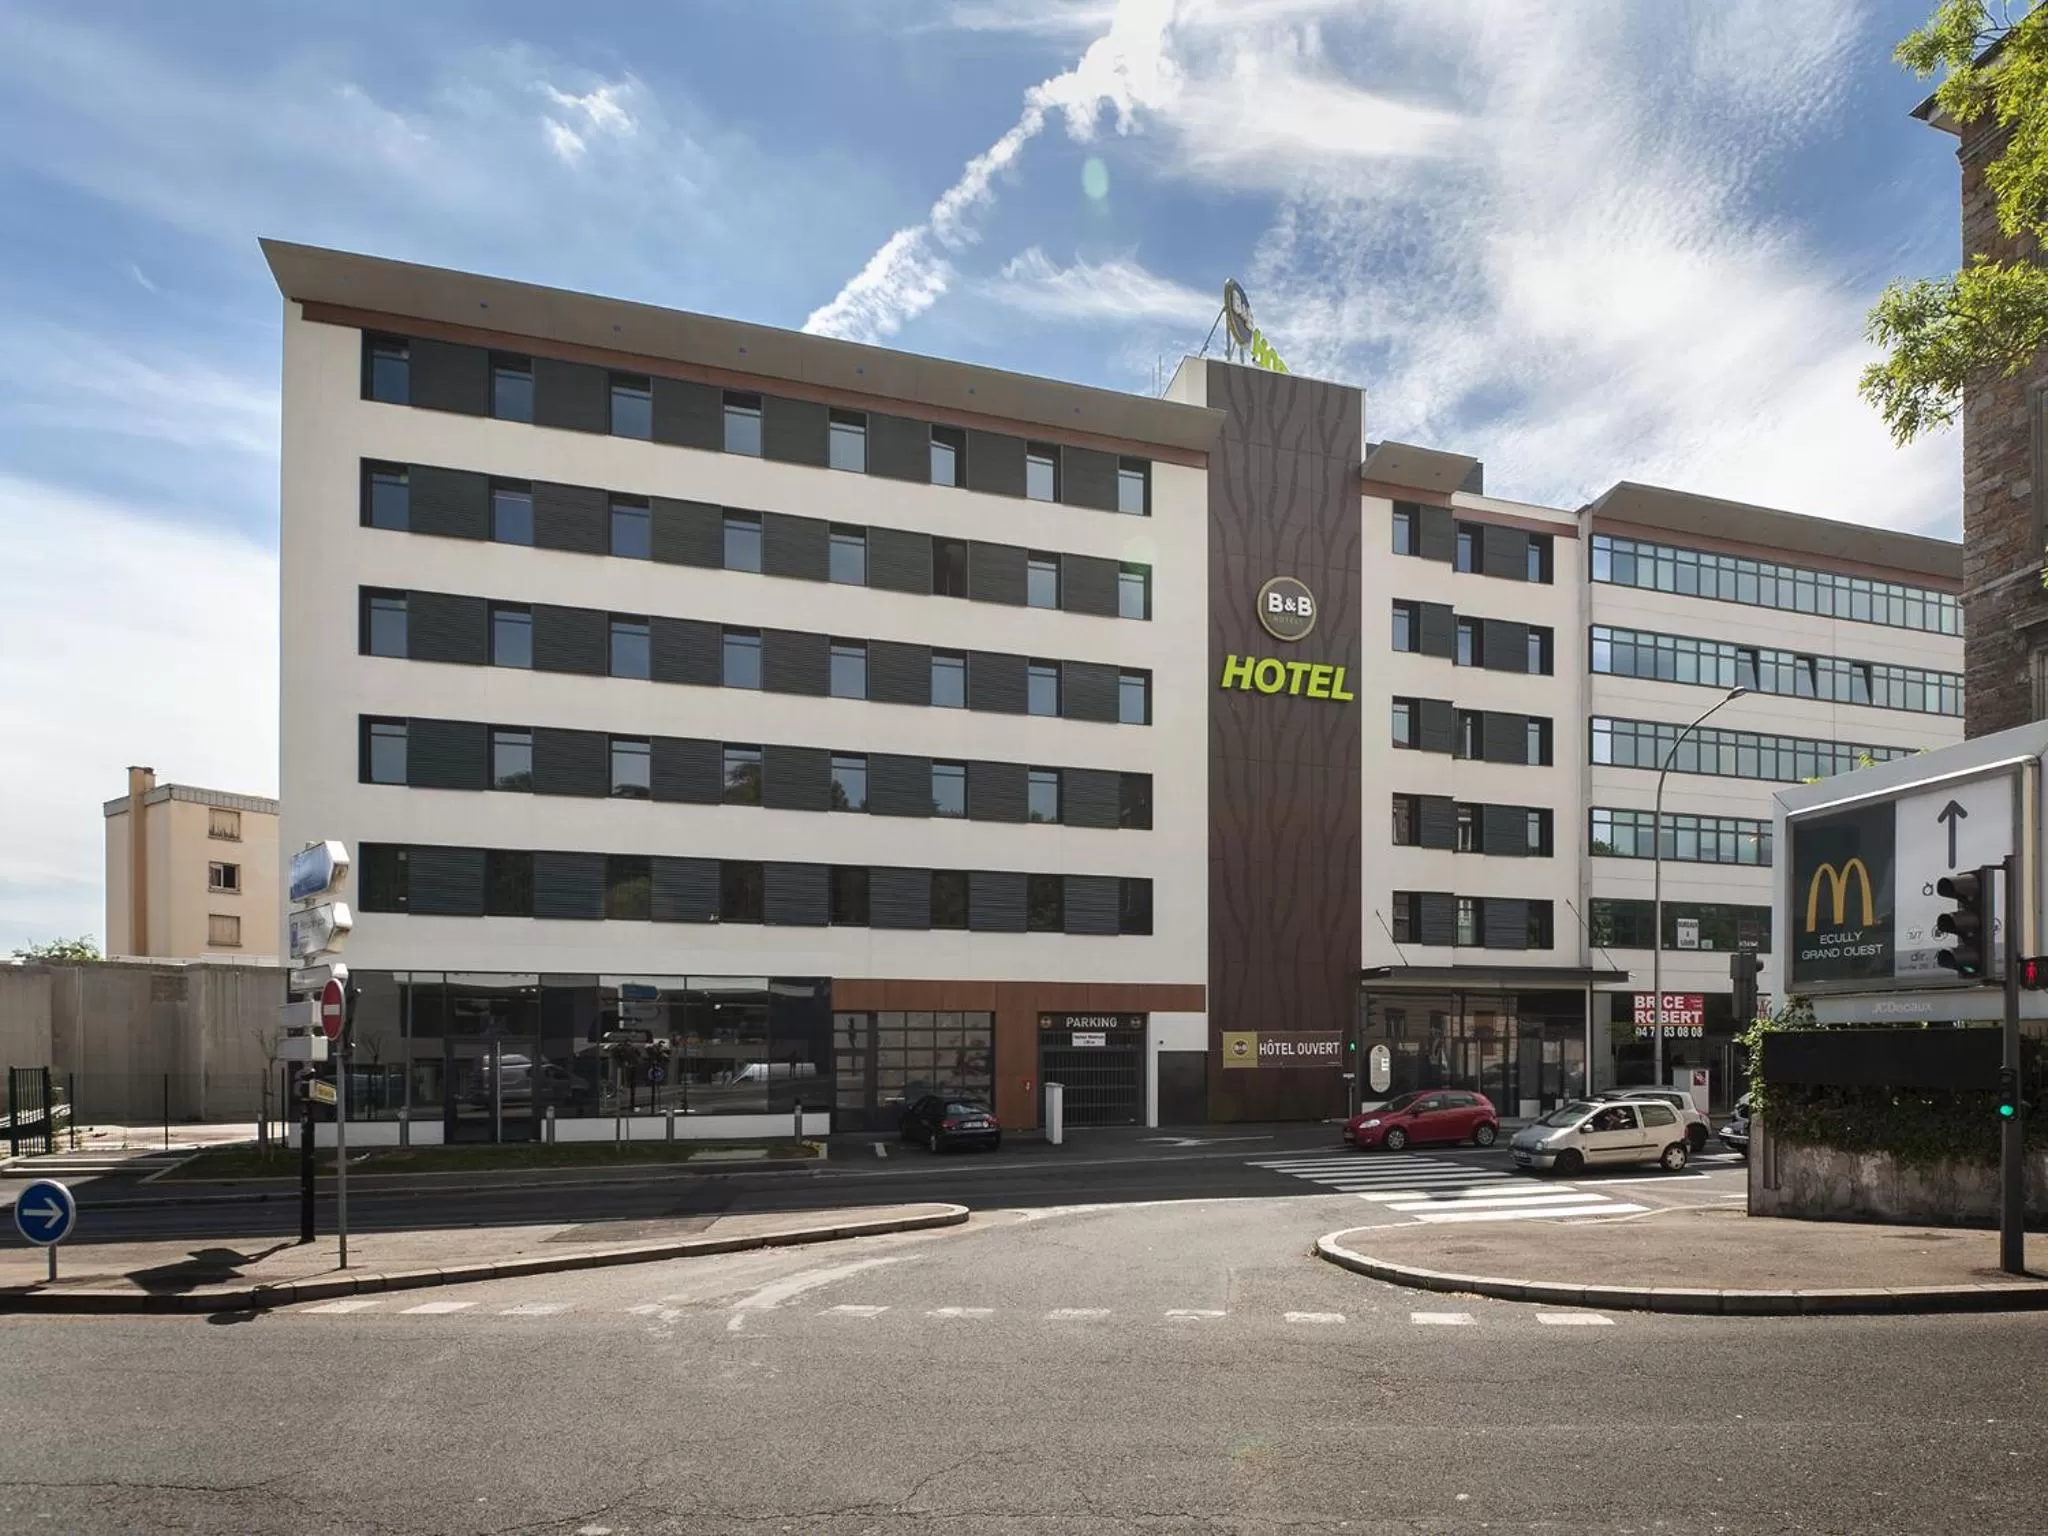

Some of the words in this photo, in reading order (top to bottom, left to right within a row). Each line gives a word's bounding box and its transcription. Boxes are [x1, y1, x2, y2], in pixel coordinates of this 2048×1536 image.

[1269, 592, 1312, 616] B&B
[1221, 655, 1354, 701] HOTEL
[1820, 931, 1862, 944] ECULLY
[1802, 948, 1840, 960] GRAND
[1843, 944, 1884, 957] OUEST
[1635, 996, 1684, 1009] BRCE
[1066, 1016, 1117, 1028] PARKING
[1635, 1011, 1702, 1024] ROBERT
[1664, 1026, 1675, 1037] 83
[1677, 1026, 1689, 1037] 08
[1691, 1026, 1703, 1037] 08
[1259, 1039, 1294, 1055] HÔTEL
[1297, 1042, 1340, 1055] OUVERT
